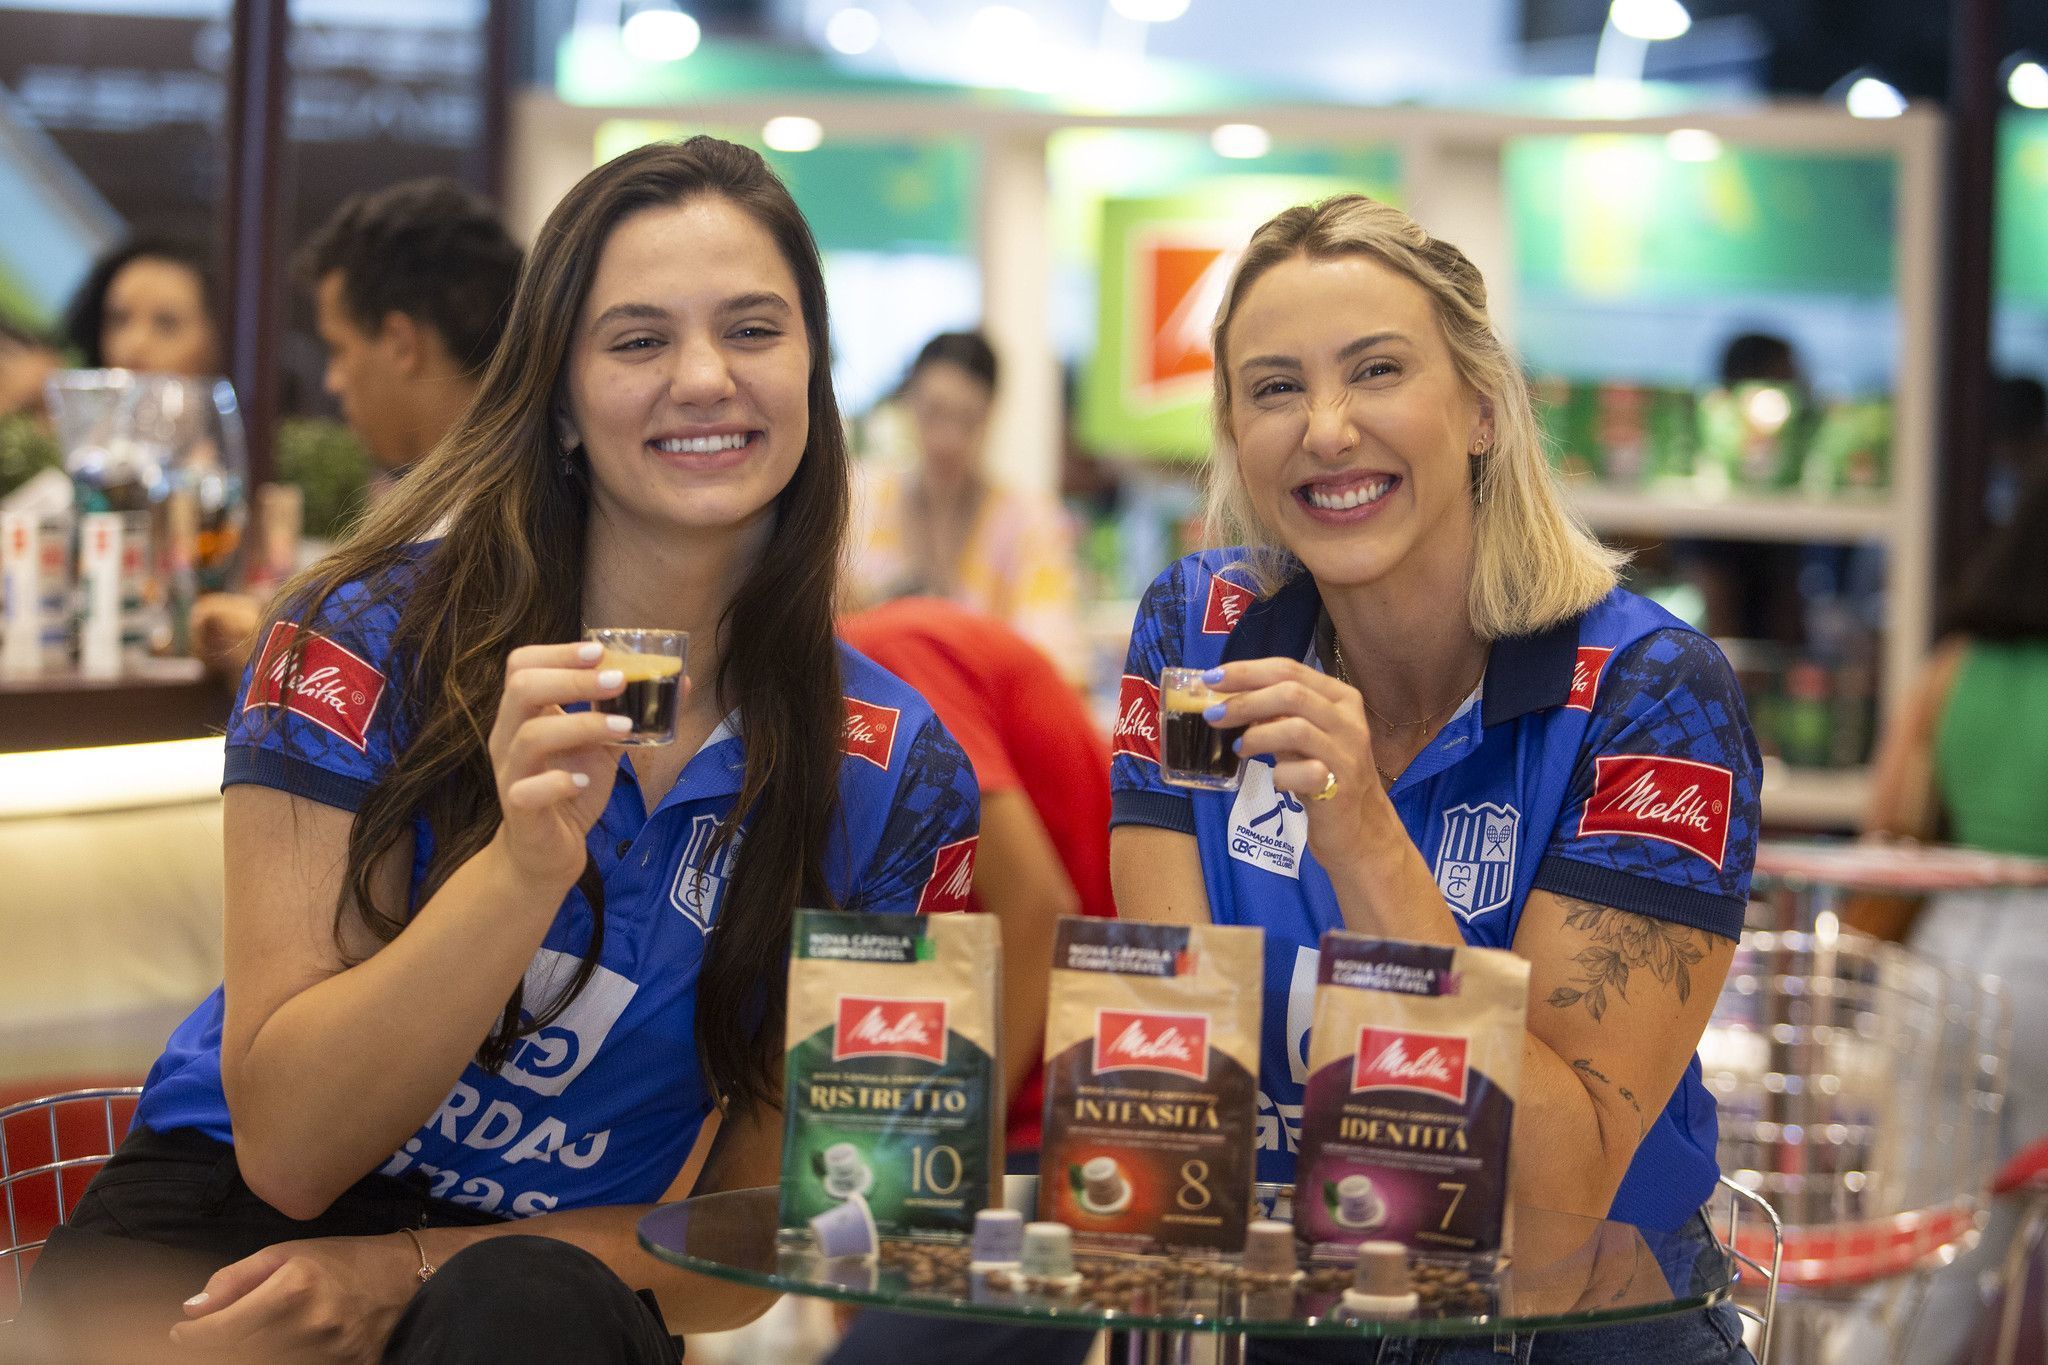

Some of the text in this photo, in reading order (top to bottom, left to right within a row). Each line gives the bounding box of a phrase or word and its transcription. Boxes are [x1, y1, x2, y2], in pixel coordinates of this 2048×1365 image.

[263, 649, 349, 714] Melitta
[1600, 769, 1713, 833] Melitta
[1232, 838, 1257, 857] CBC
[1236, 825, 1274, 845] FORMAÇÃO
[845, 1005, 929, 1045] Melitta
[1105, 1019, 1192, 1062] Melitta
[1365, 1037, 1450, 1083] Melitta
[810, 1084, 967, 1113] RISTRETTO
[380, 1137, 558, 1219] inas
[912, 1144, 963, 1195] 10
[1177, 1159, 1211, 1210] 8
[1438, 1183, 1467, 1231] 7
